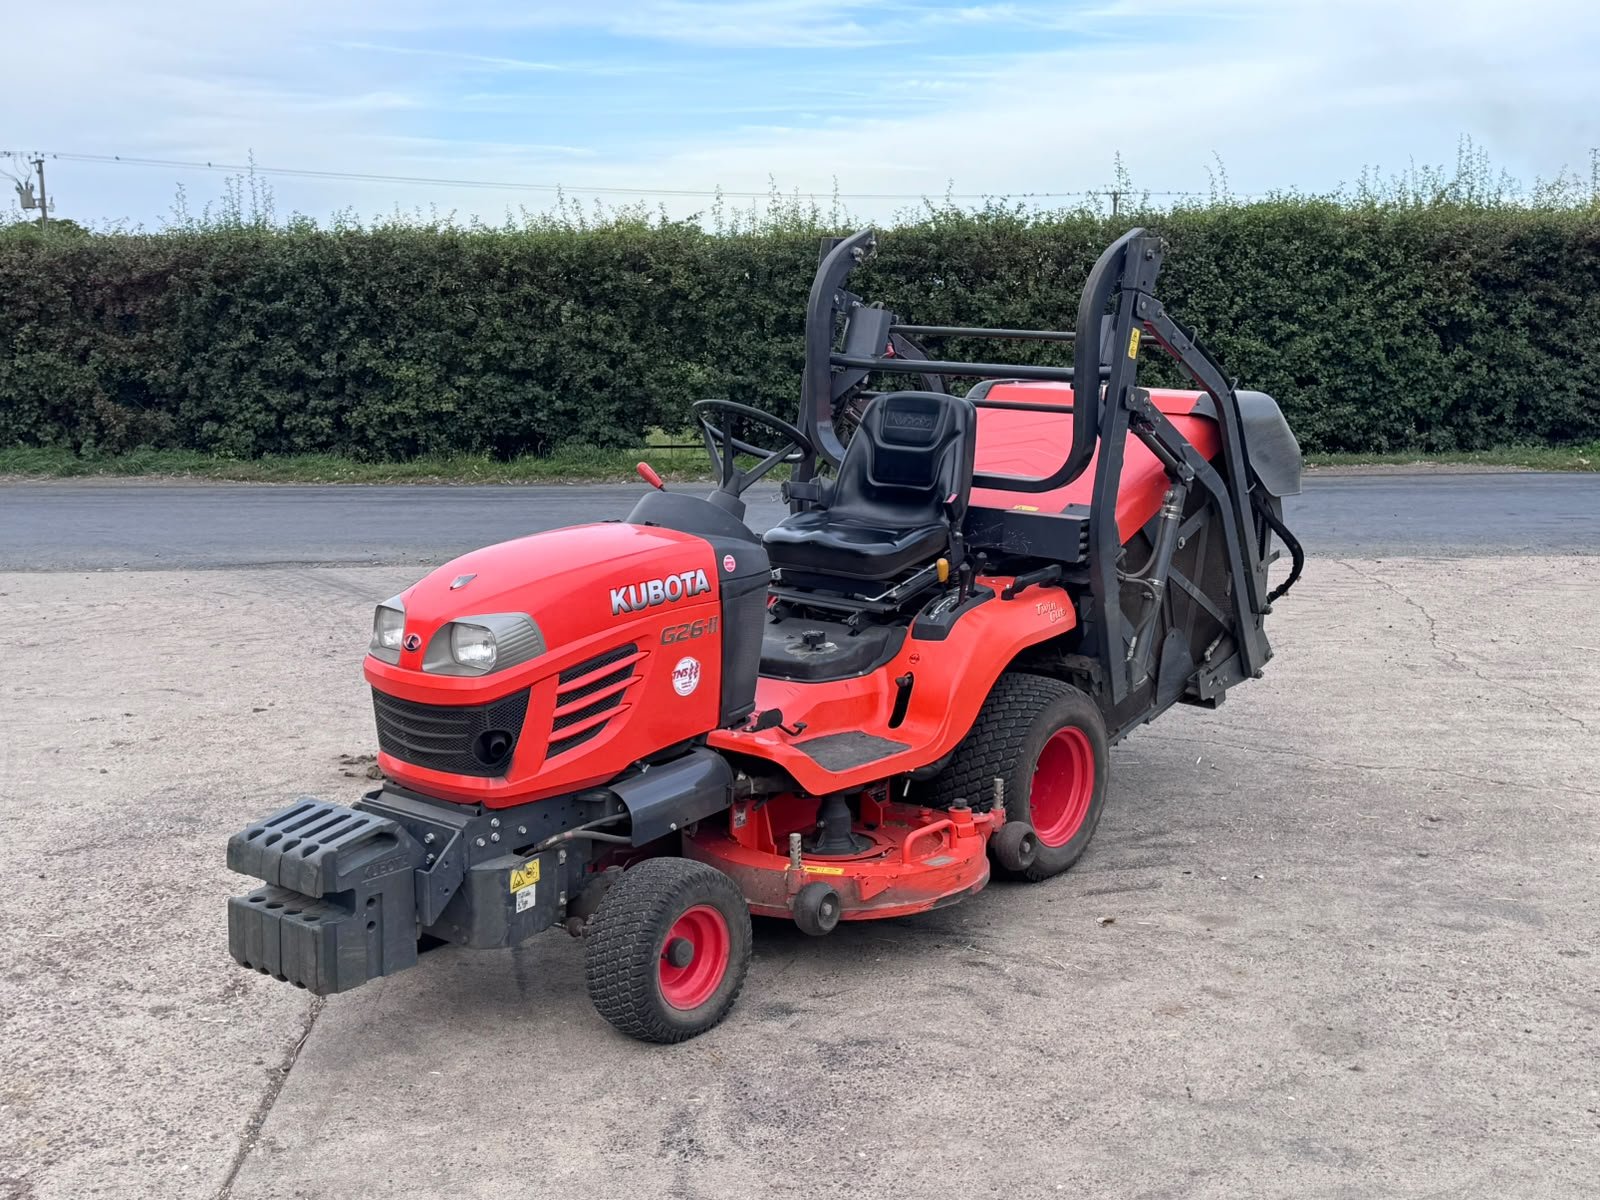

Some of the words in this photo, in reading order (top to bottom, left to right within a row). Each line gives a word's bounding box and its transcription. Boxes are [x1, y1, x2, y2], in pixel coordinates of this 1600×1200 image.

[609, 568, 711, 616] KUBOTA
[1035, 600, 1057, 616] Twin
[672, 666, 689, 680] TNS
